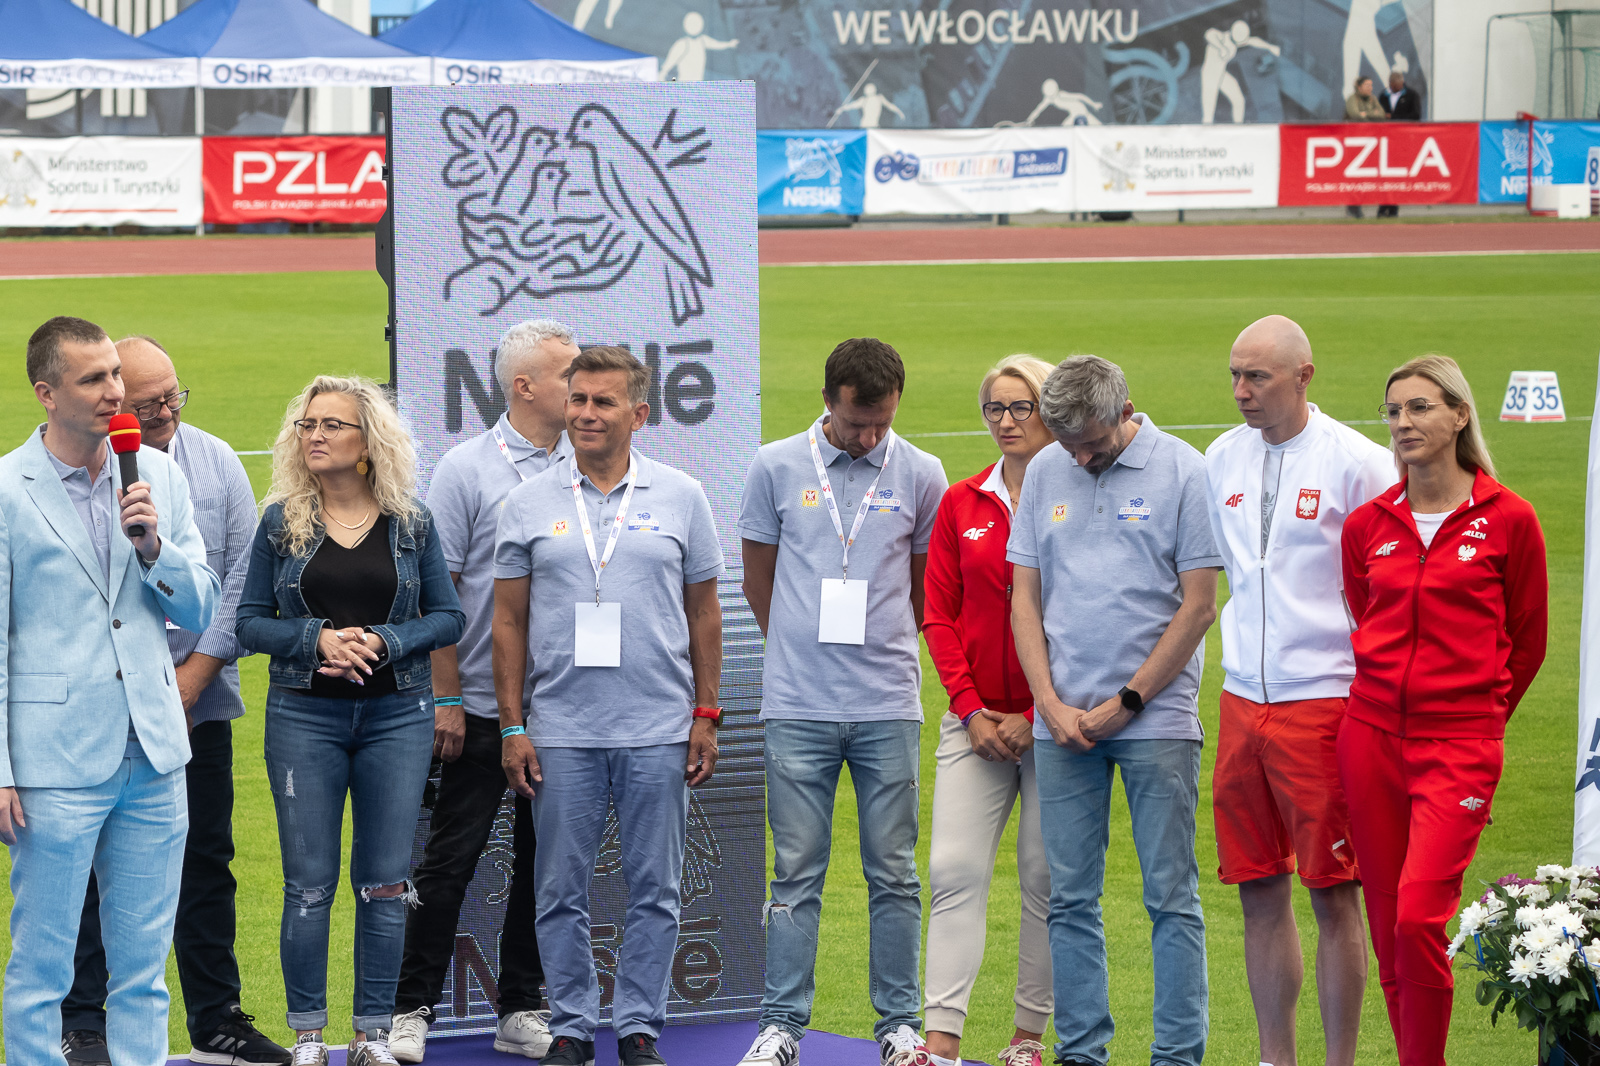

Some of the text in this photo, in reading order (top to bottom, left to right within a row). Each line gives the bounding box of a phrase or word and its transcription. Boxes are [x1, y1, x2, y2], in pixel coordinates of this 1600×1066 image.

[832, 9, 1139, 45] WE WŁOCŁAWKU
[1145, 145, 1227, 160] Ministerstwo
[1306, 136, 1451, 178] PZLA
[47, 156, 148, 174] Ministerstwo
[233, 150, 386, 195] PZLA
[1144, 164, 1188, 180] Sportu
[1198, 162, 1254, 179] Turystyki
[47, 178, 98, 198] Sportu
[113, 177, 180, 198] Turystyki
[1506, 386, 1527, 411] 35
[1533, 386, 1559, 411] 35
[1225, 493, 1243, 507] 4F
[963, 527, 988, 541] 4F
[1375, 540, 1399, 556] 4F
[1459, 796, 1485, 812] 4F
